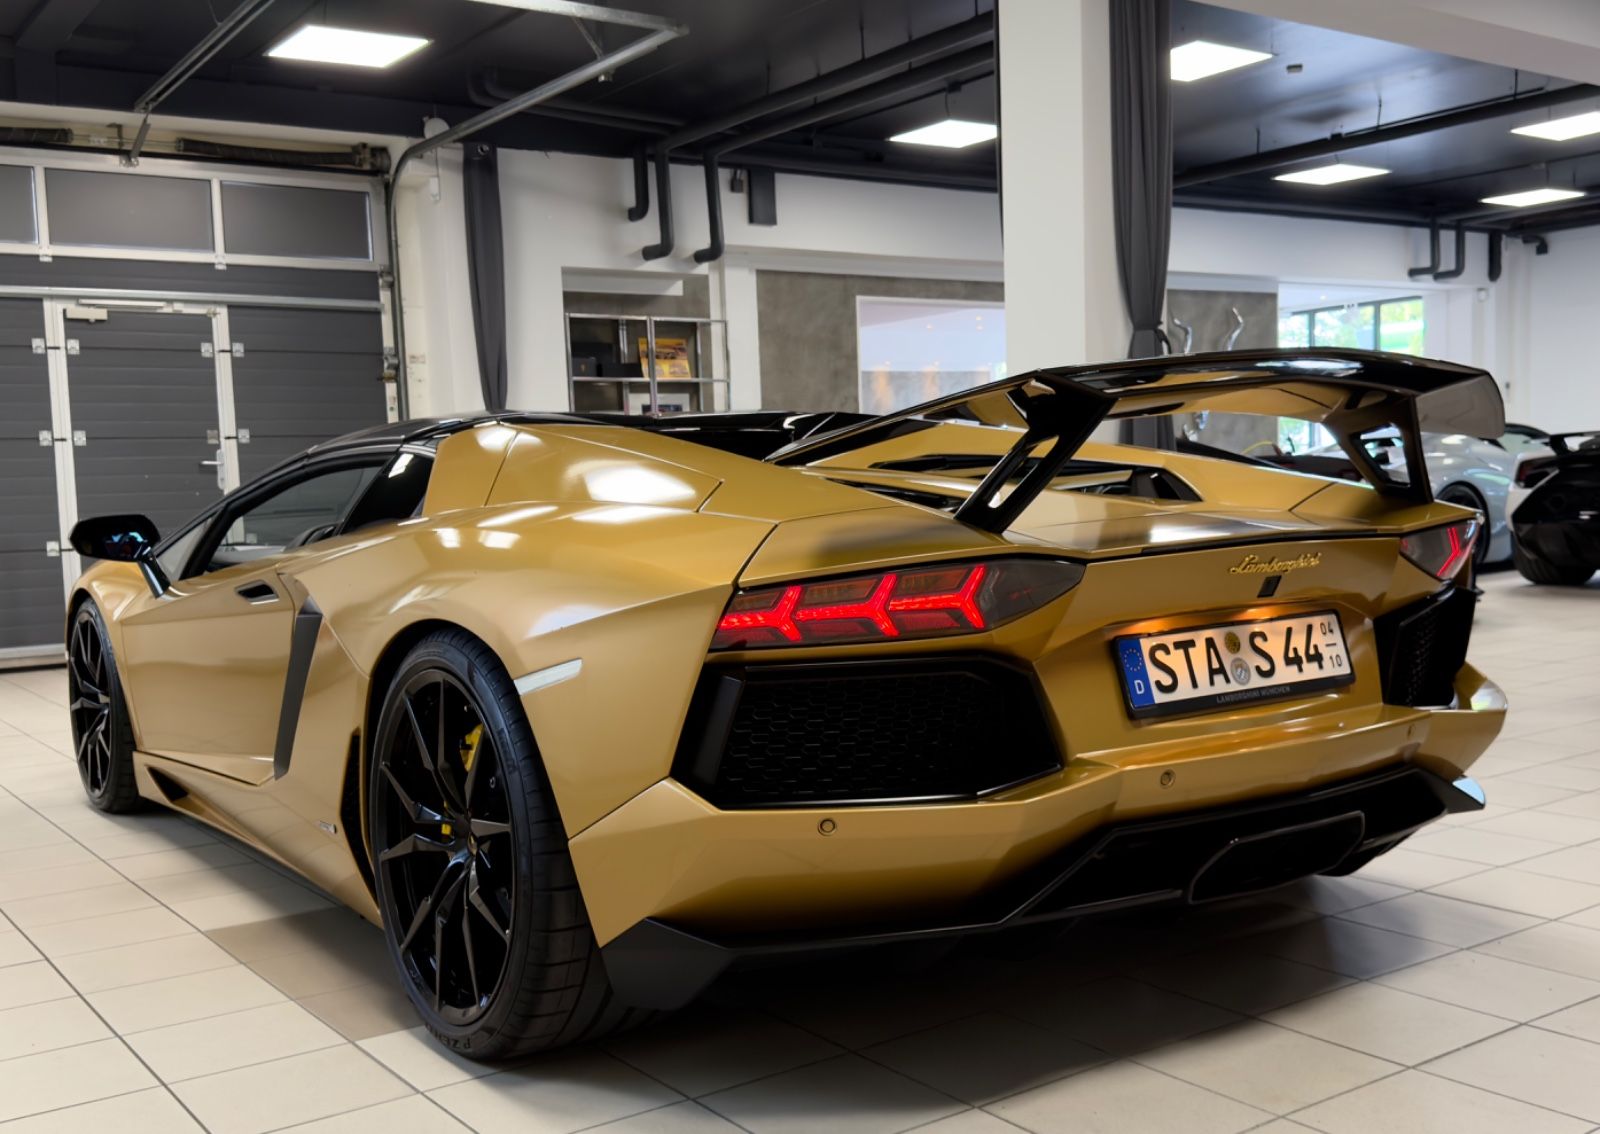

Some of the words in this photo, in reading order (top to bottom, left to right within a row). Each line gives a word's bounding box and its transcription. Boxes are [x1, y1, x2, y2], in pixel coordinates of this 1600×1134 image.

[1230, 552, 1322, 574] Lamborghini
[1319, 621, 1335, 636] 04
[1149, 636, 1231, 694] STA
[1248, 630, 1276, 679] S
[1283, 623, 1324, 673] 44
[1329, 654, 1343, 668] 10
[1133, 679, 1145, 695] D
